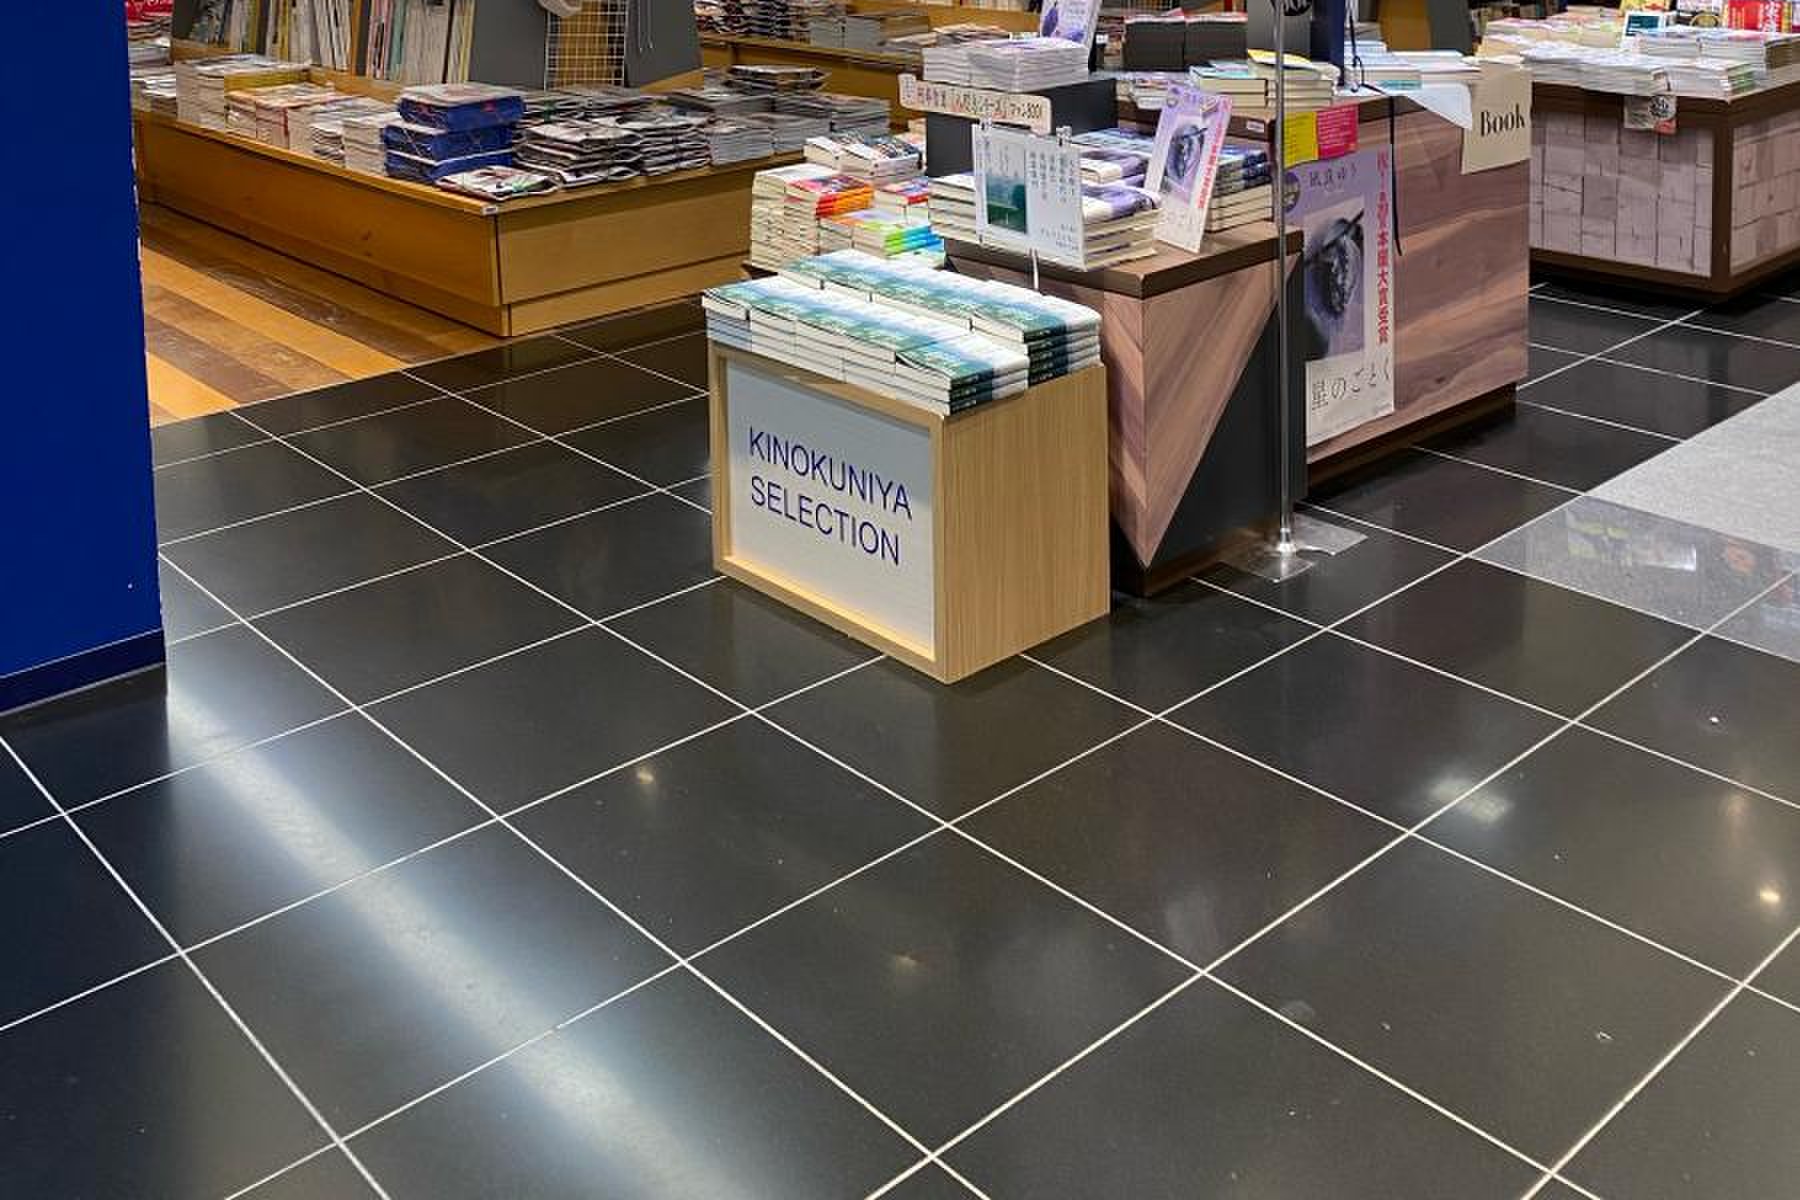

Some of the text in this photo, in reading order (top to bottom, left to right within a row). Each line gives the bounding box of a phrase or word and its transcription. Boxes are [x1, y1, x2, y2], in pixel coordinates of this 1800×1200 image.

[1480, 103, 1526, 138] Book
[749, 425, 913, 521] KINOKUNIYA
[750, 474, 900, 567] SELECTION
